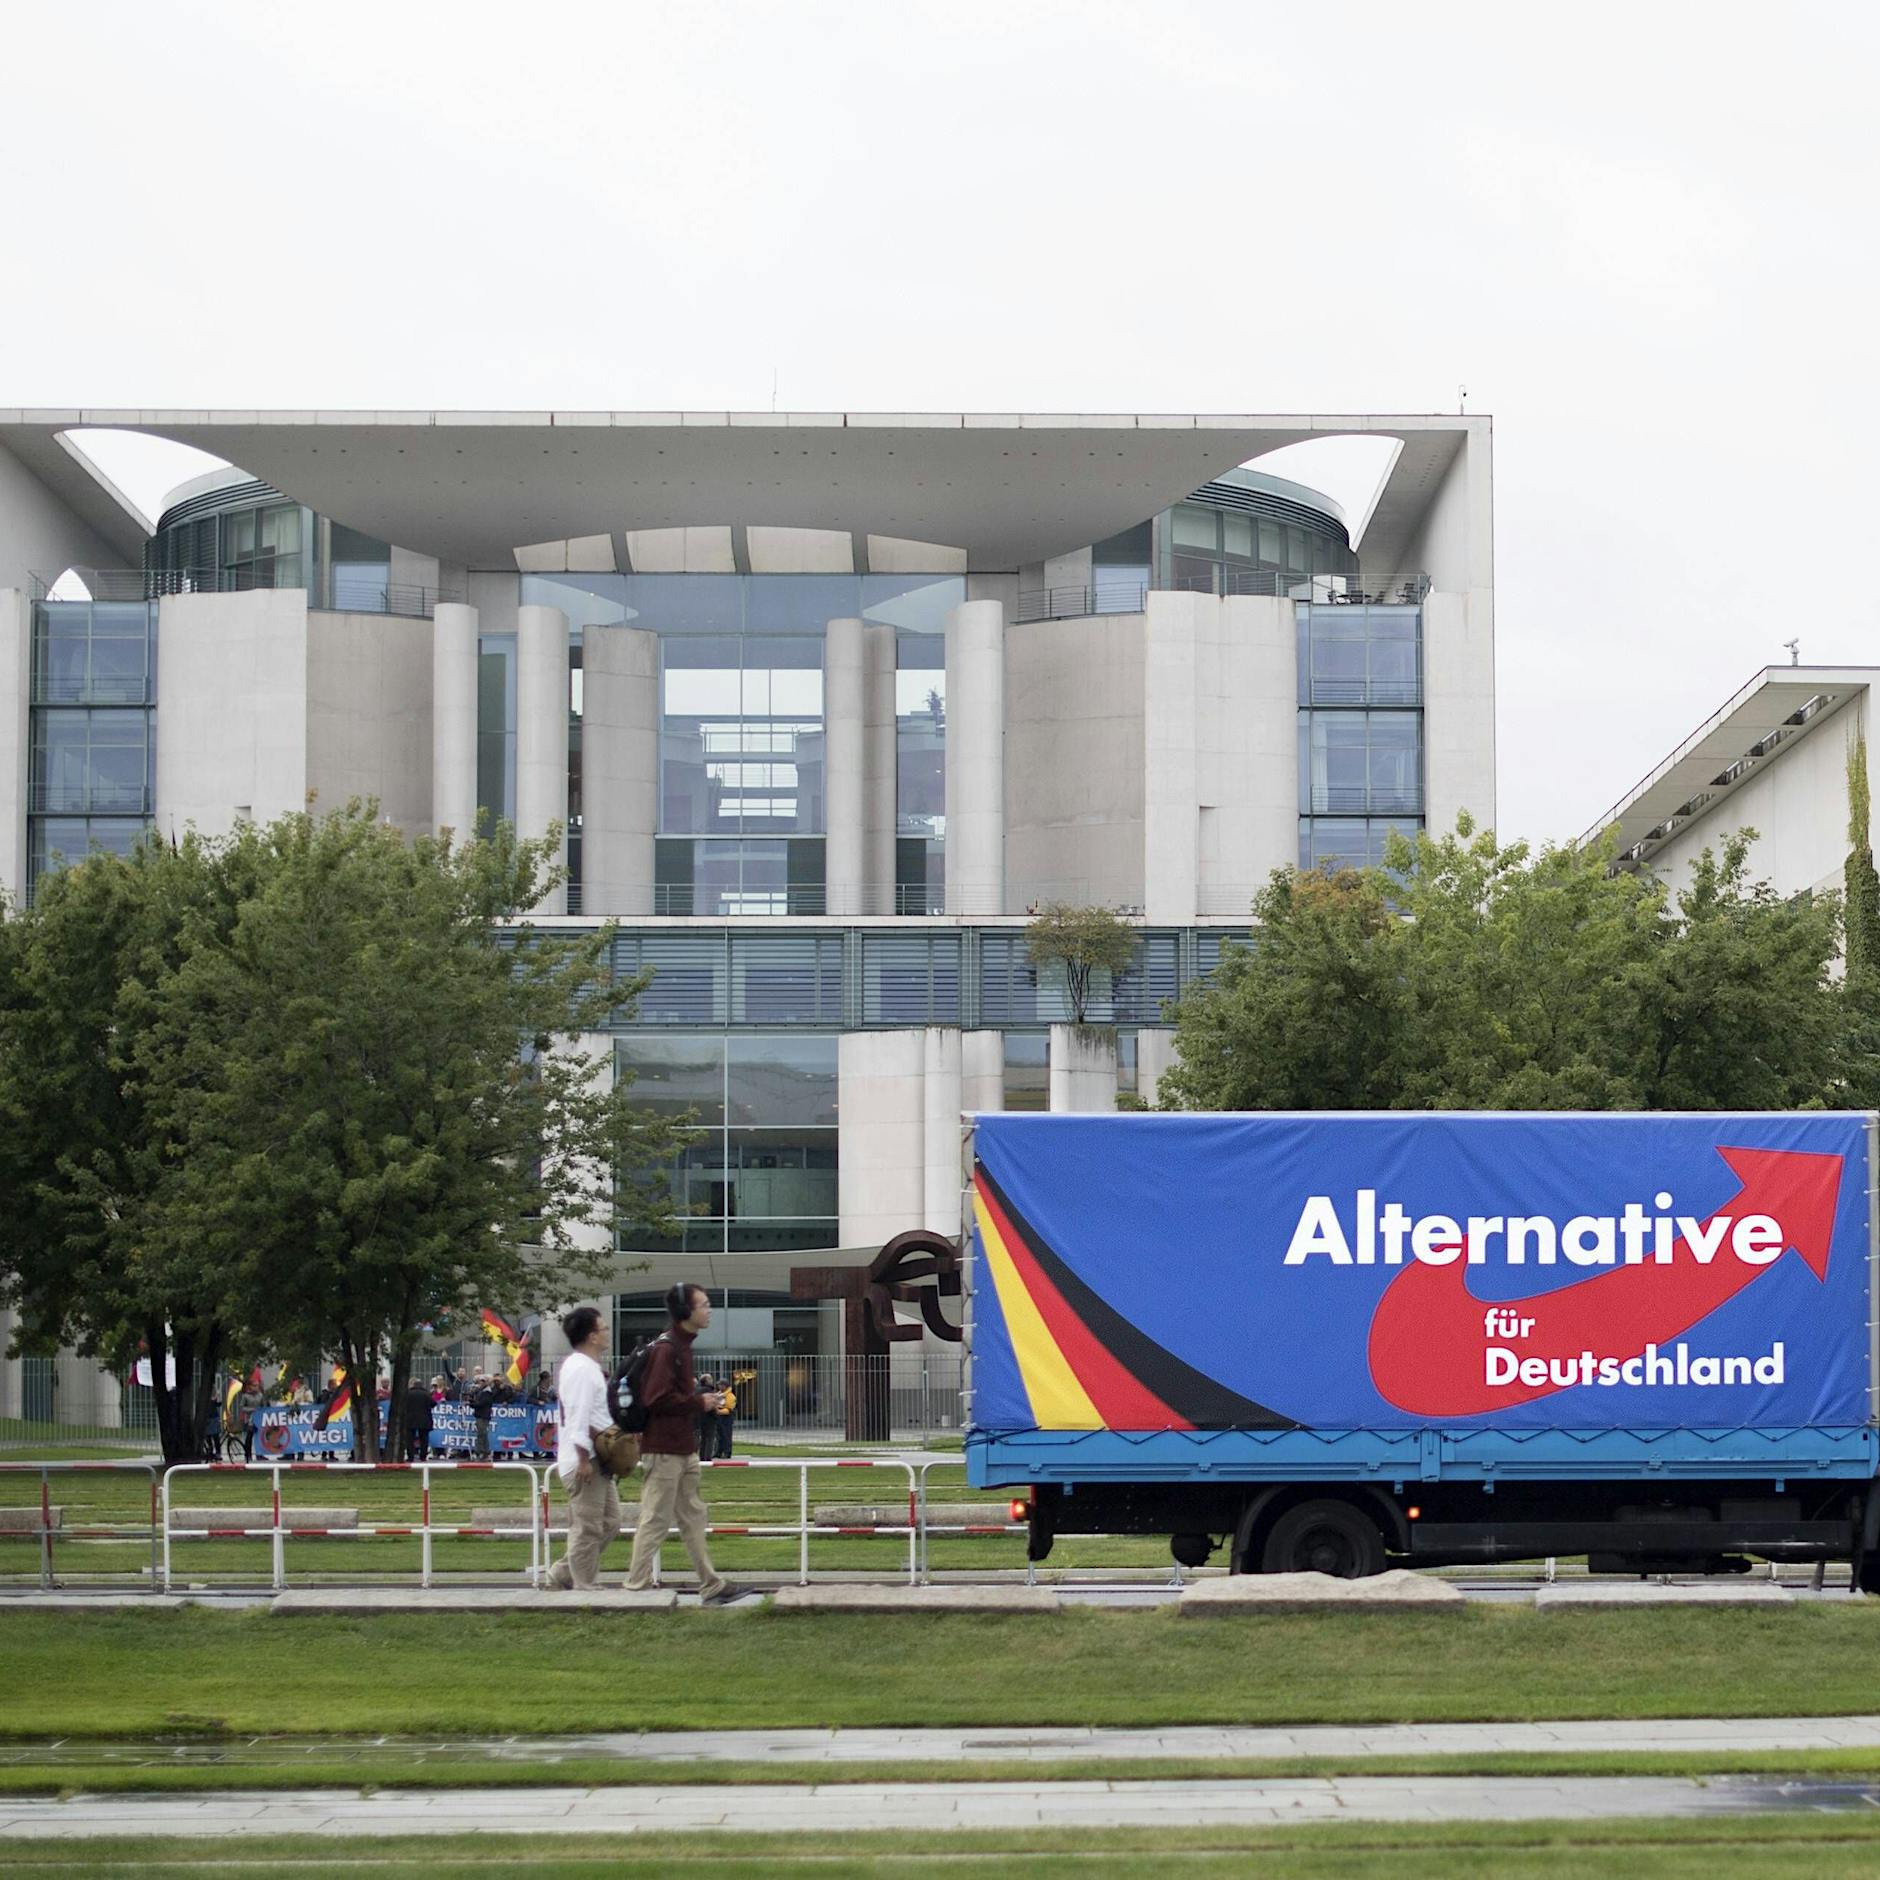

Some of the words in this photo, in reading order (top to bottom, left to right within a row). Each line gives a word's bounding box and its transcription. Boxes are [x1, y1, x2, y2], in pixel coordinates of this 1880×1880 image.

[1283, 1189, 1784, 1266] Alternative
[1484, 1308, 1536, 1338] für
[1485, 1342, 1785, 1386] Deutschland
[298, 1429, 348, 1444] WEG!
[441, 1434, 478, 1447] JETZT
